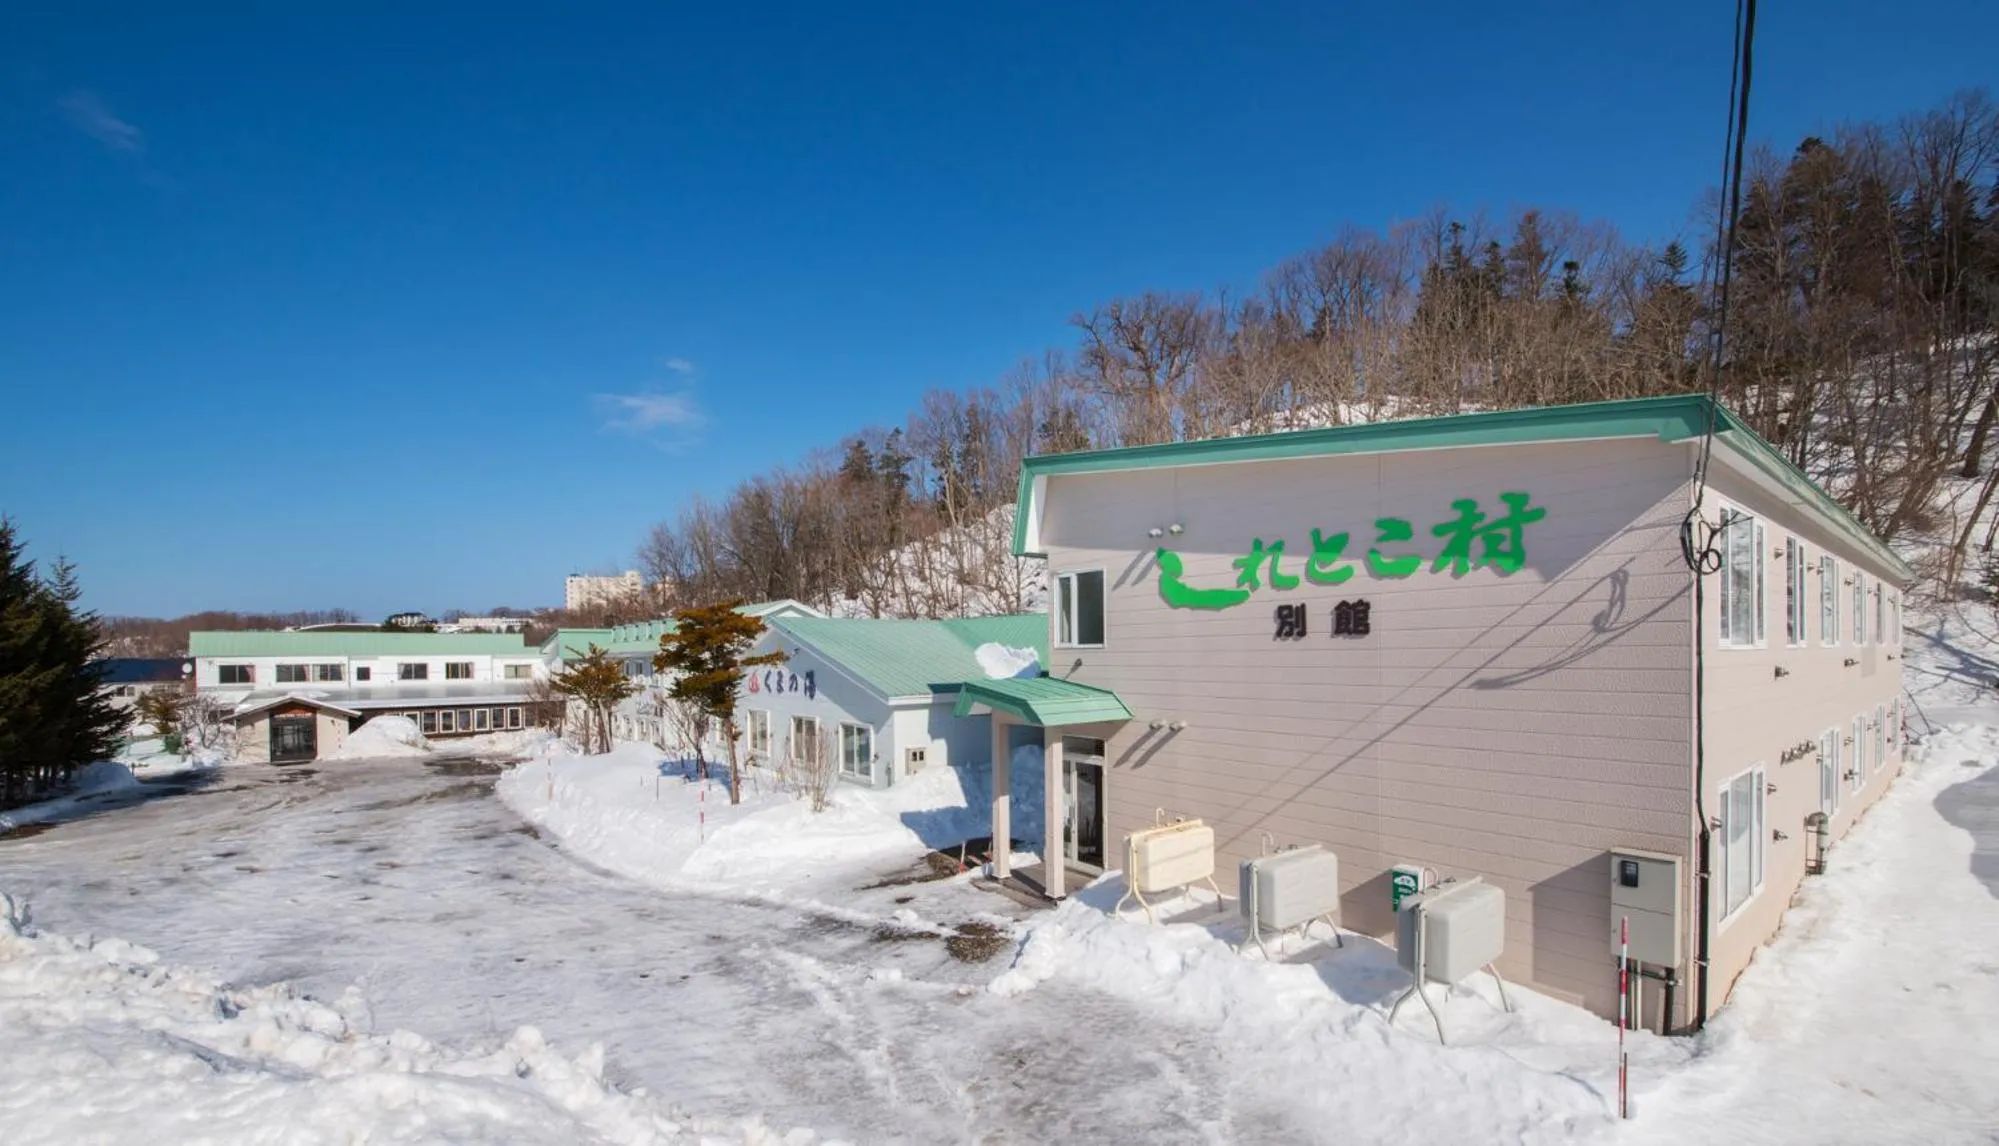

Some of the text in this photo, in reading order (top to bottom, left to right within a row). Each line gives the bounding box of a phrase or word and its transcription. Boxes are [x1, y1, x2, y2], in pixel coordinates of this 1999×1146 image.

[1158, 492, 1546, 610] しれとこ村
